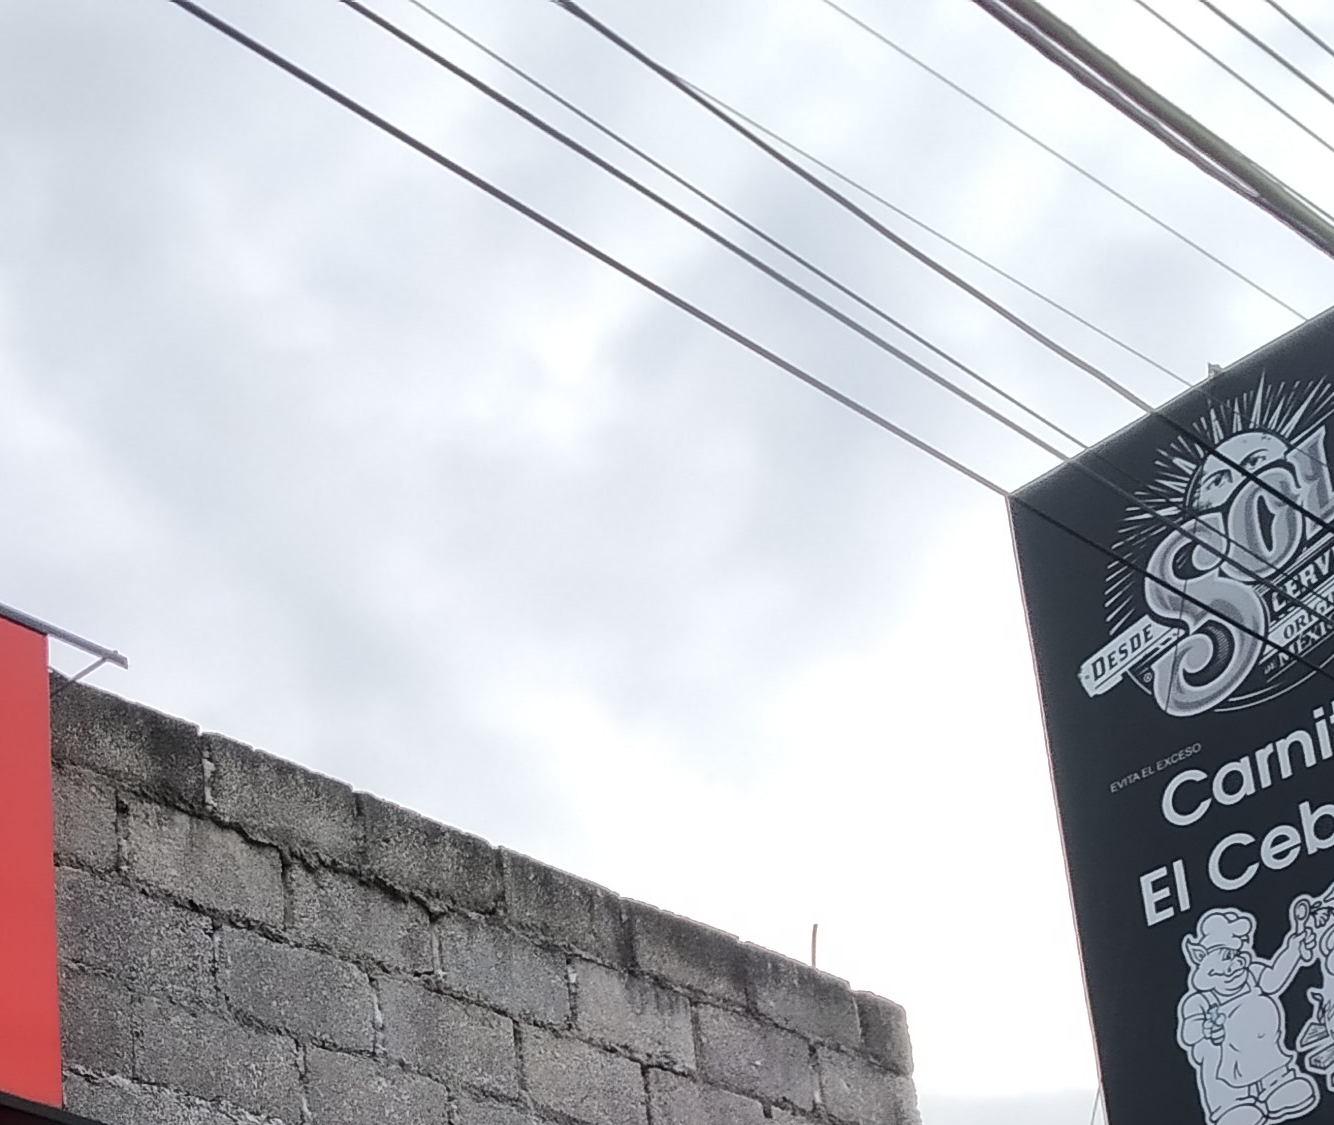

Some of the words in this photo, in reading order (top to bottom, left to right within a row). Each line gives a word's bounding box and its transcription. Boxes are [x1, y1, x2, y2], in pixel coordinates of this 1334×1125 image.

[1091, 623, 1154, 682] DESDE
[1109, 773, 1142, 794] EVITA
[1141, 766, 1155, 779] EL
[1156, 741, 1203, 771] EXCESO
[1139, 859, 1191, 926] El
